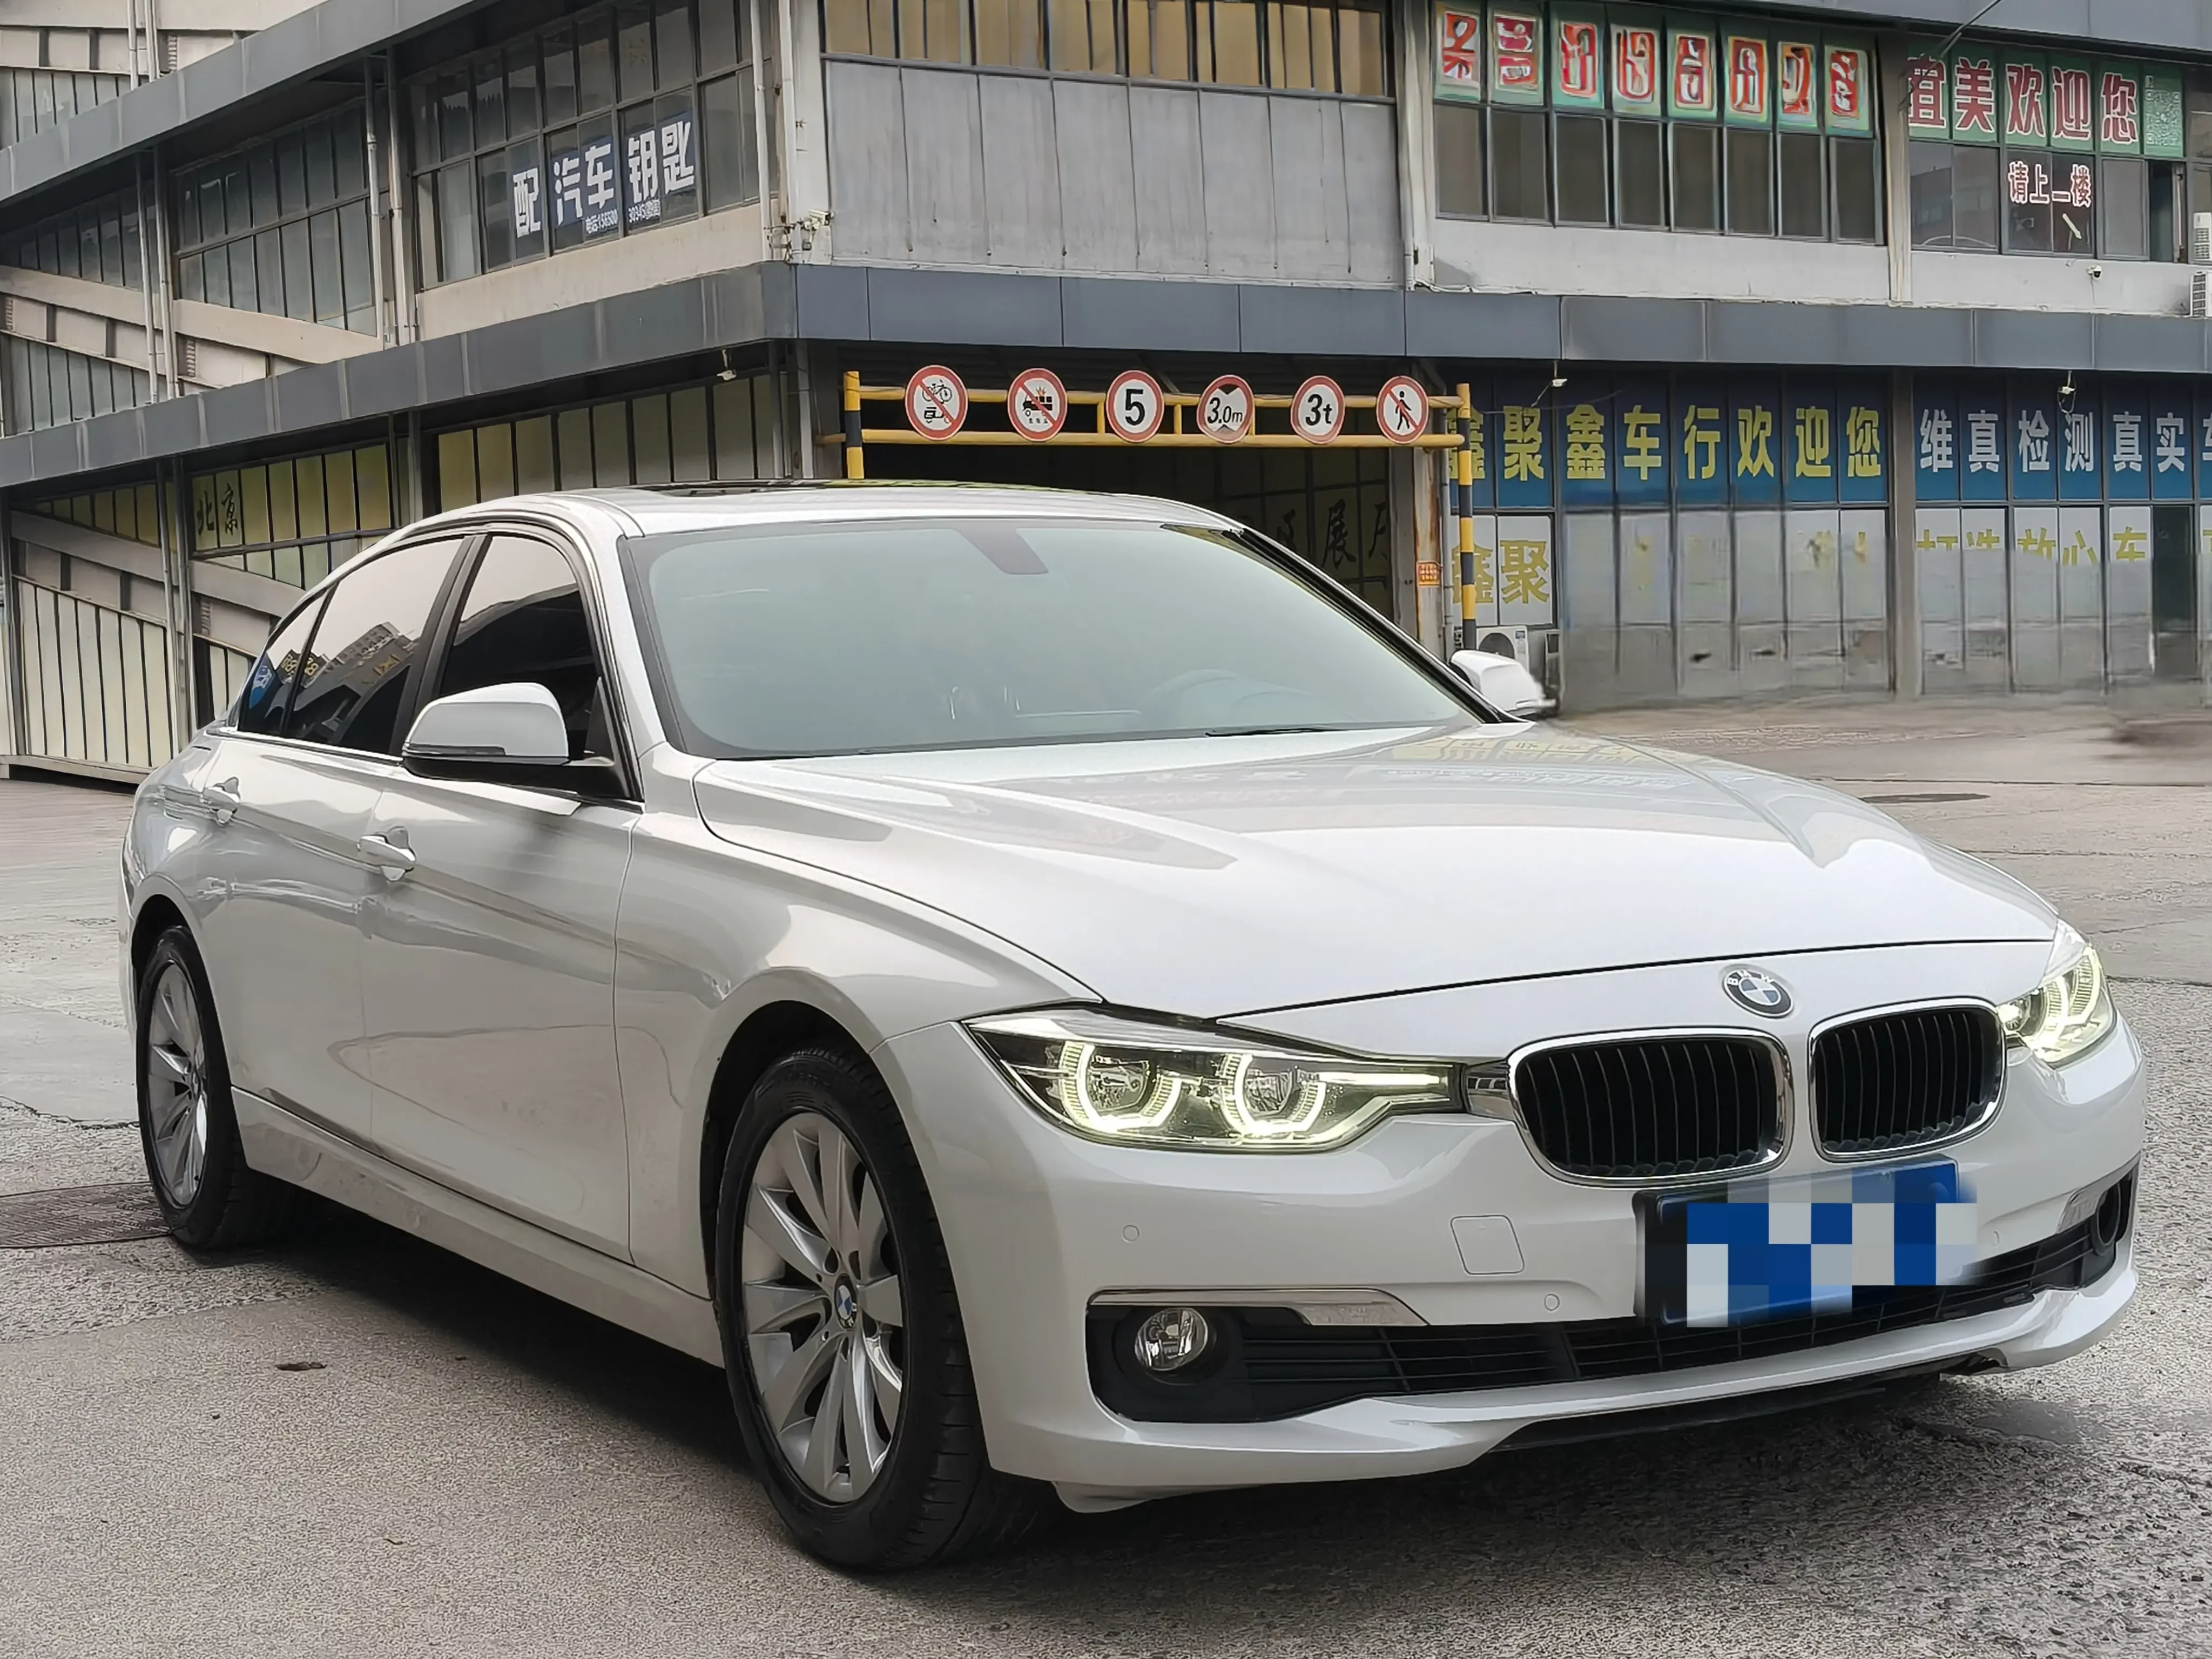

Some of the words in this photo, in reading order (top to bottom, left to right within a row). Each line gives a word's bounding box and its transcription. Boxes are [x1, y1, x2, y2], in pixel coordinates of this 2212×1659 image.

[512, 120, 694, 238] 配汽车钥匙
[2008, 160, 2092, 208] 请上一楼
[1125, 388, 1145, 426] 5
[1207, 395, 1243, 424] 3.0m
[1305, 393, 1333, 427] 3t
[196, 482, 238, 536] 北京
